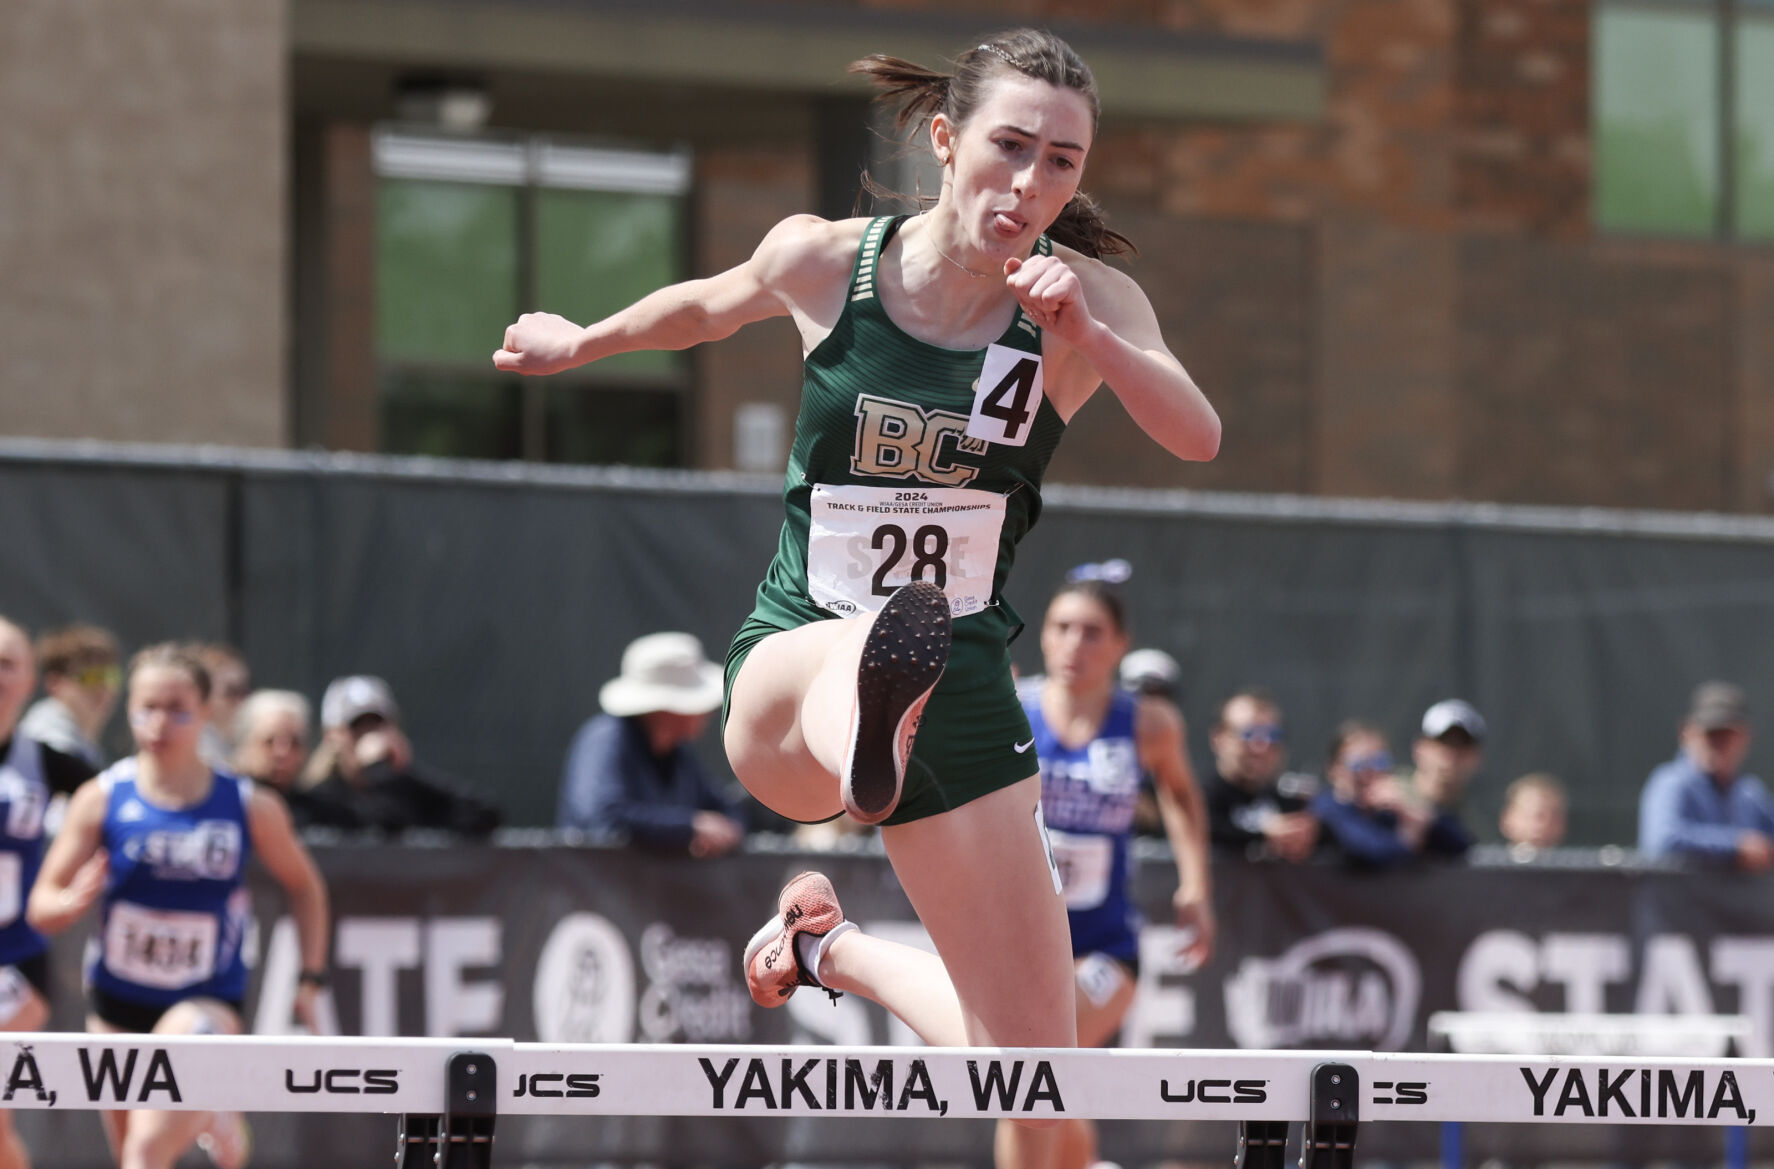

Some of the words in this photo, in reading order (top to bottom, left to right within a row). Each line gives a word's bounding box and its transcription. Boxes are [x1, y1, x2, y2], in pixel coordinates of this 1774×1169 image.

[980, 358, 1039, 439] 4
[850, 393, 988, 488] BC
[827, 503, 856, 511] TRACK
[866, 505, 890, 514] FIELD
[922, 504, 991, 514] CHAMPIONSHIPS
[895, 492, 928, 501] 2024
[871, 524, 949, 596] 28
[243, 915, 503, 1037] ATE
[78, 1047, 183, 1102] WA
[285, 1068, 399, 1094] UCS
[697, 1057, 949, 1117] YAKIMA,
[965, 1059, 1066, 1112] WA
[1160, 1079, 1268, 1104] UCS
[1519, 1067, 1757, 1124] YAKIMA,
